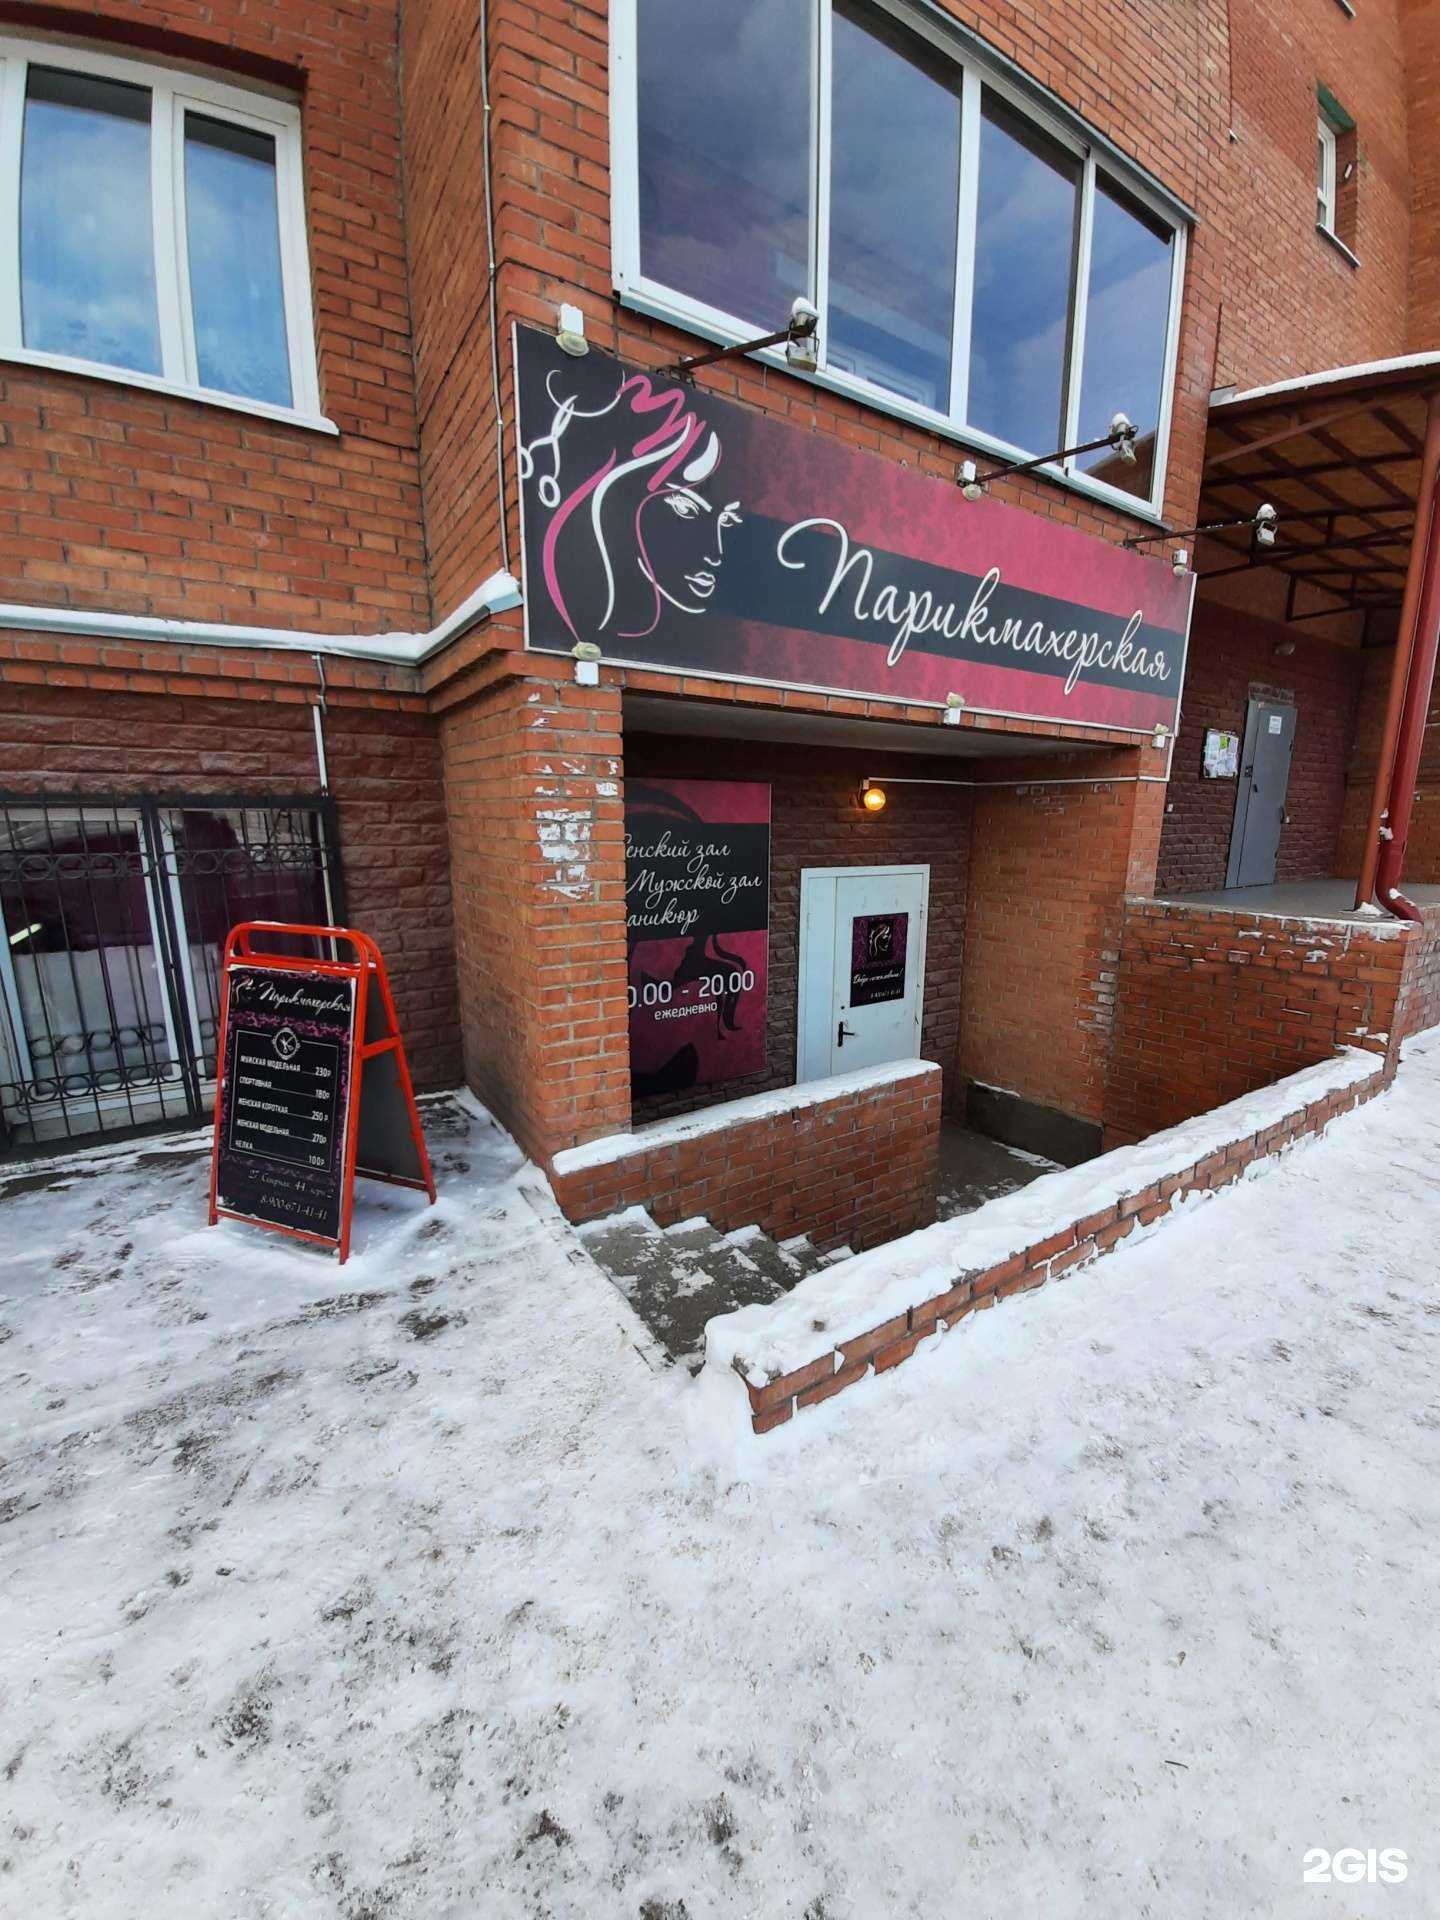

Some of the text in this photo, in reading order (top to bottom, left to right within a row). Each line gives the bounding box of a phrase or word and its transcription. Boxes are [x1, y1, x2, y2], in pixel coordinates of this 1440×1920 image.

[777, 517, 1171, 696] Парикмахерская
[687, 843, 730, 873] зал
[626, 864, 761, 909] Мужской зал
[627, 898, 699, 935] аникюр
[628, 981, 672, 1008] 0.00
[698, 970, 755, 998] 20.00
[654, 1001, 718, 1020] ежедневно
[262, 1102, 289, 1114] КОРОТКАЯ
